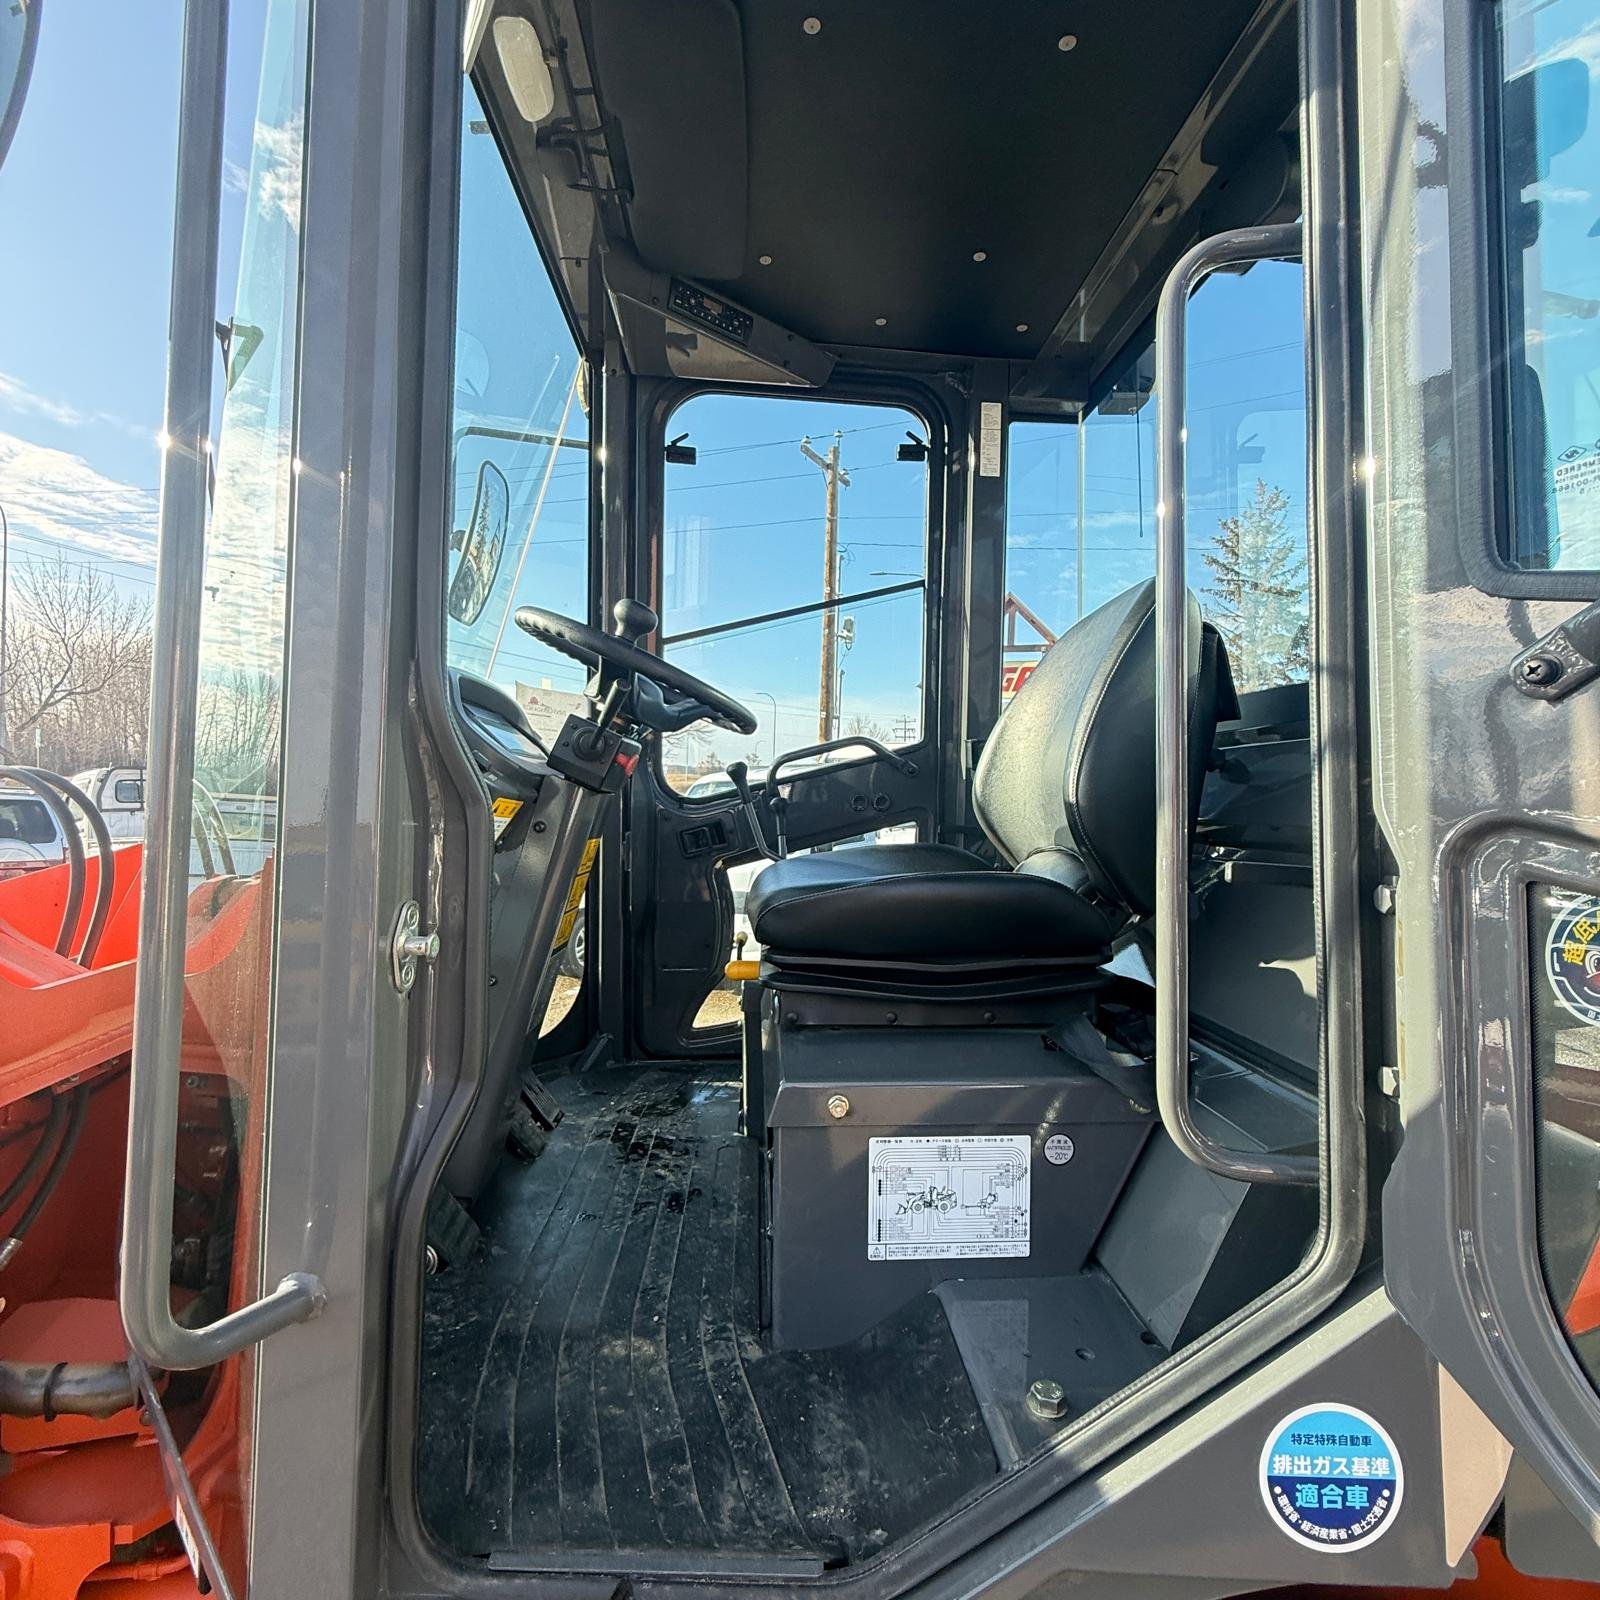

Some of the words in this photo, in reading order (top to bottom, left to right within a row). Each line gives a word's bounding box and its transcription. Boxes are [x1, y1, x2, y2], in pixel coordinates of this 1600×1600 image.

[1290, 1432, 1373, 1447] 特定特殊自動車
[1272, 1454, 1391, 1477] 排出ガス基準
[1295, 1483, 1370, 1510] 適合車
